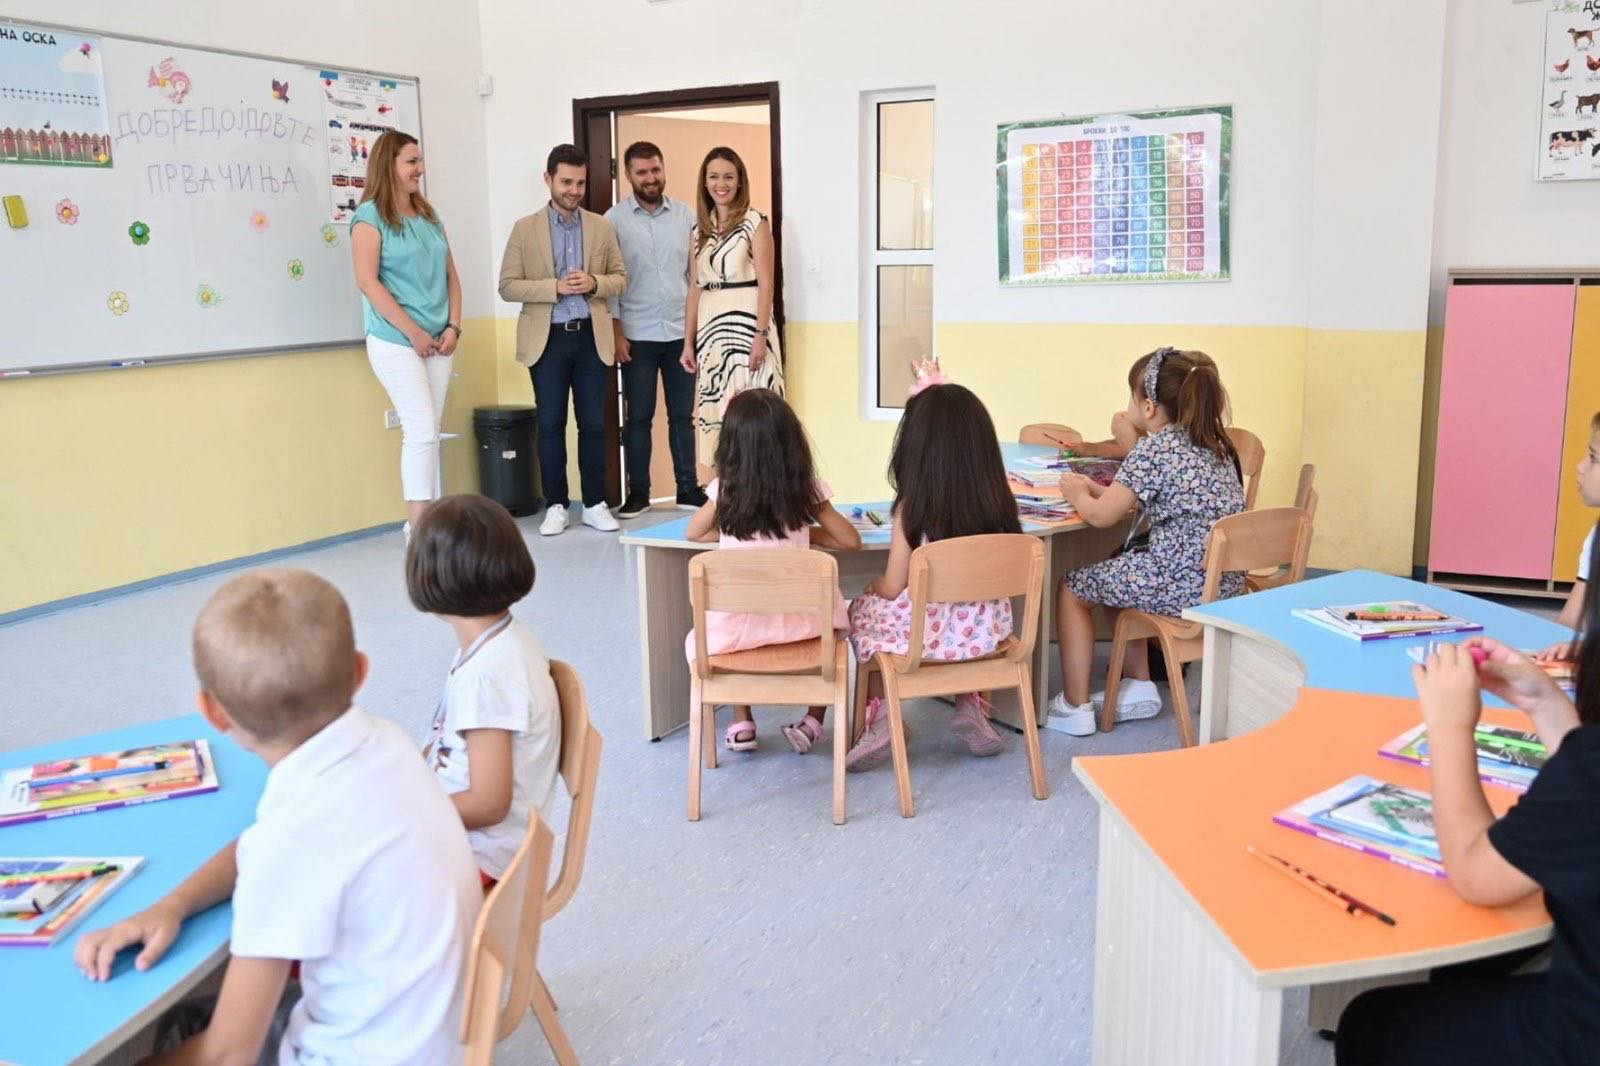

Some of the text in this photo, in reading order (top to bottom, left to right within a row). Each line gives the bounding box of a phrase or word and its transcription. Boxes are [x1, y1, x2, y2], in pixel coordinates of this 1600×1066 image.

[23, 31, 56, 45] ОСКА
[146, 163, 300, 194] ПРВАЧИЊА
[1189, 261, 1202, 269] 100
